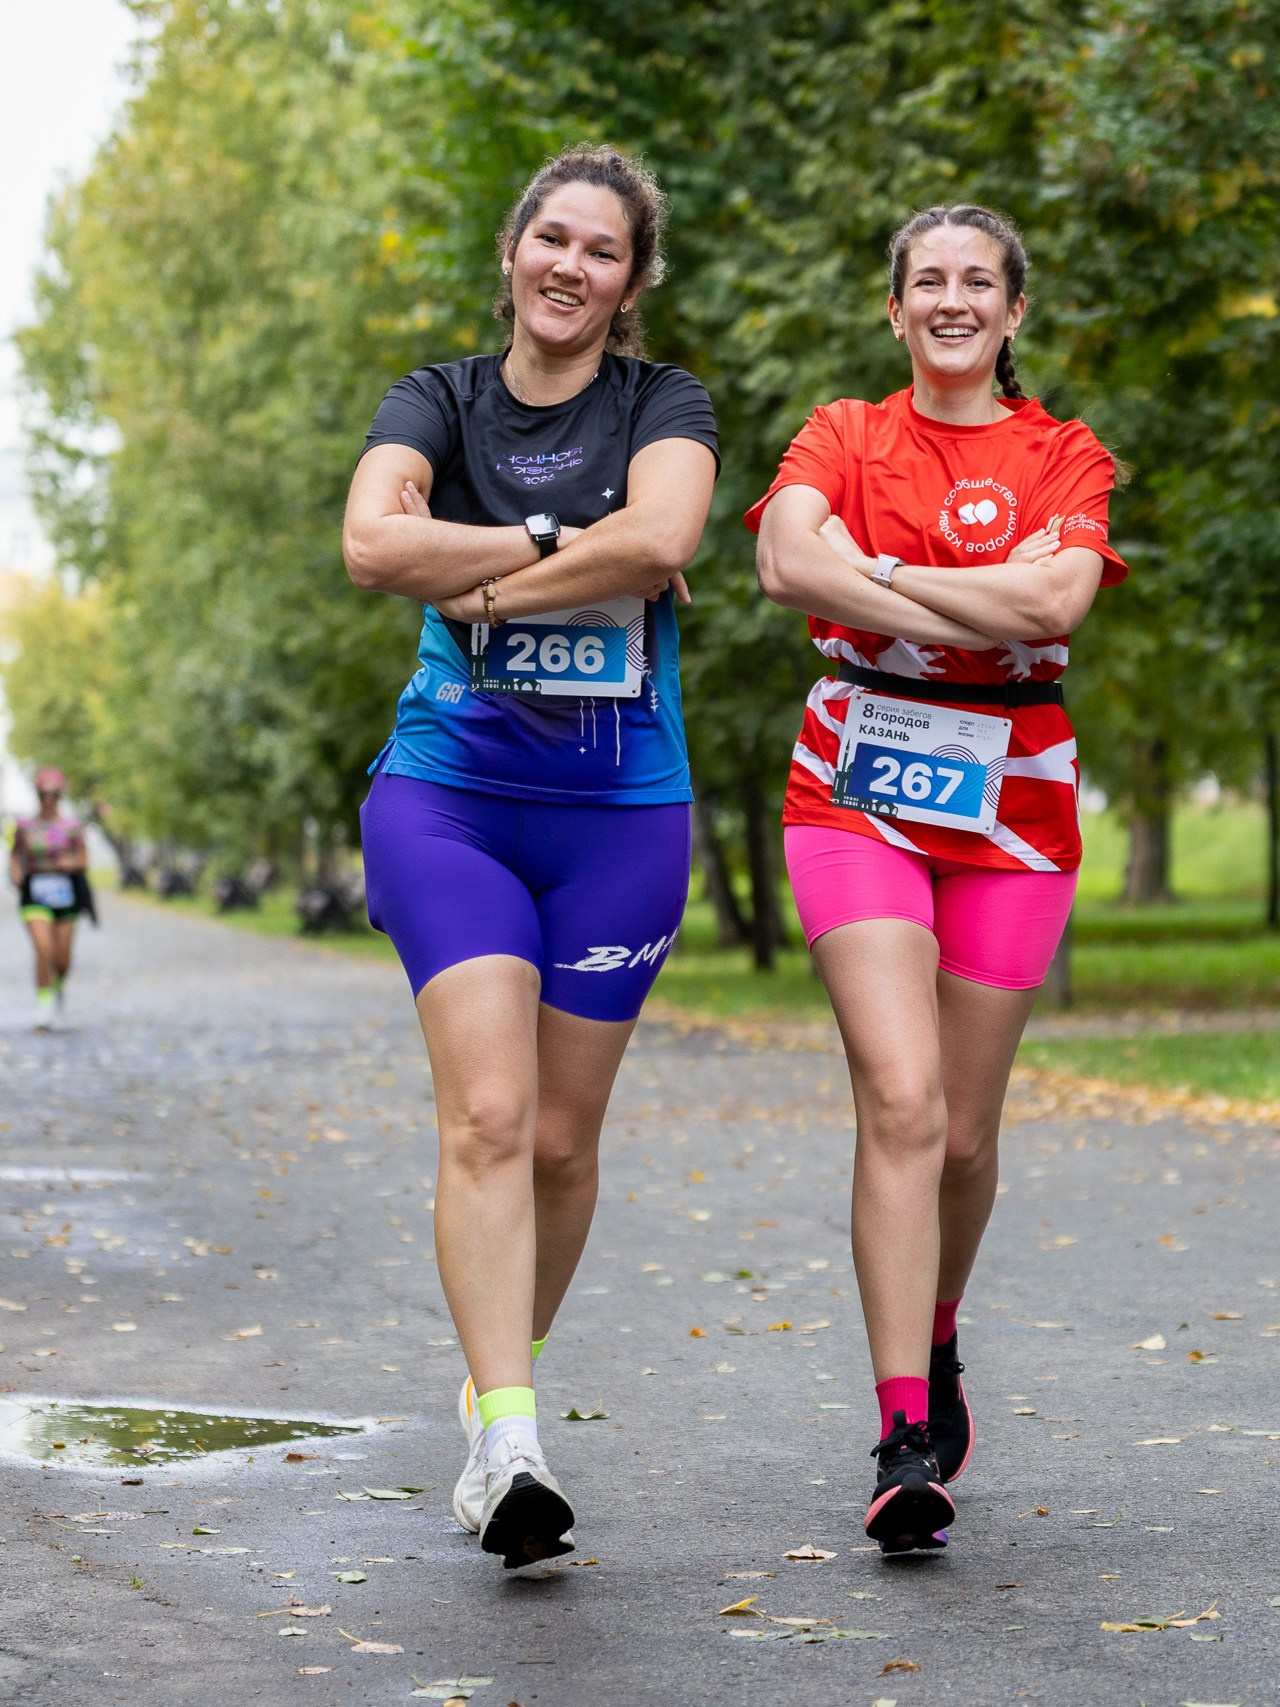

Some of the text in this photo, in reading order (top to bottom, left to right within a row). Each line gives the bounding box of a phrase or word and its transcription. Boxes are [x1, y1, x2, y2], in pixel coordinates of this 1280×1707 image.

[939, 478, 1018, 553] сообщество доноров крови
[506, 633, 605, 674] 266
[863, 703, 930, 729] 8 городов
[877, 704, 932, 719] серия забегов
[959, 719, 975, 727] спорт
[859, 724, 910, 742] КАЗАНЬ
[869, 756, 965, 805] 267
